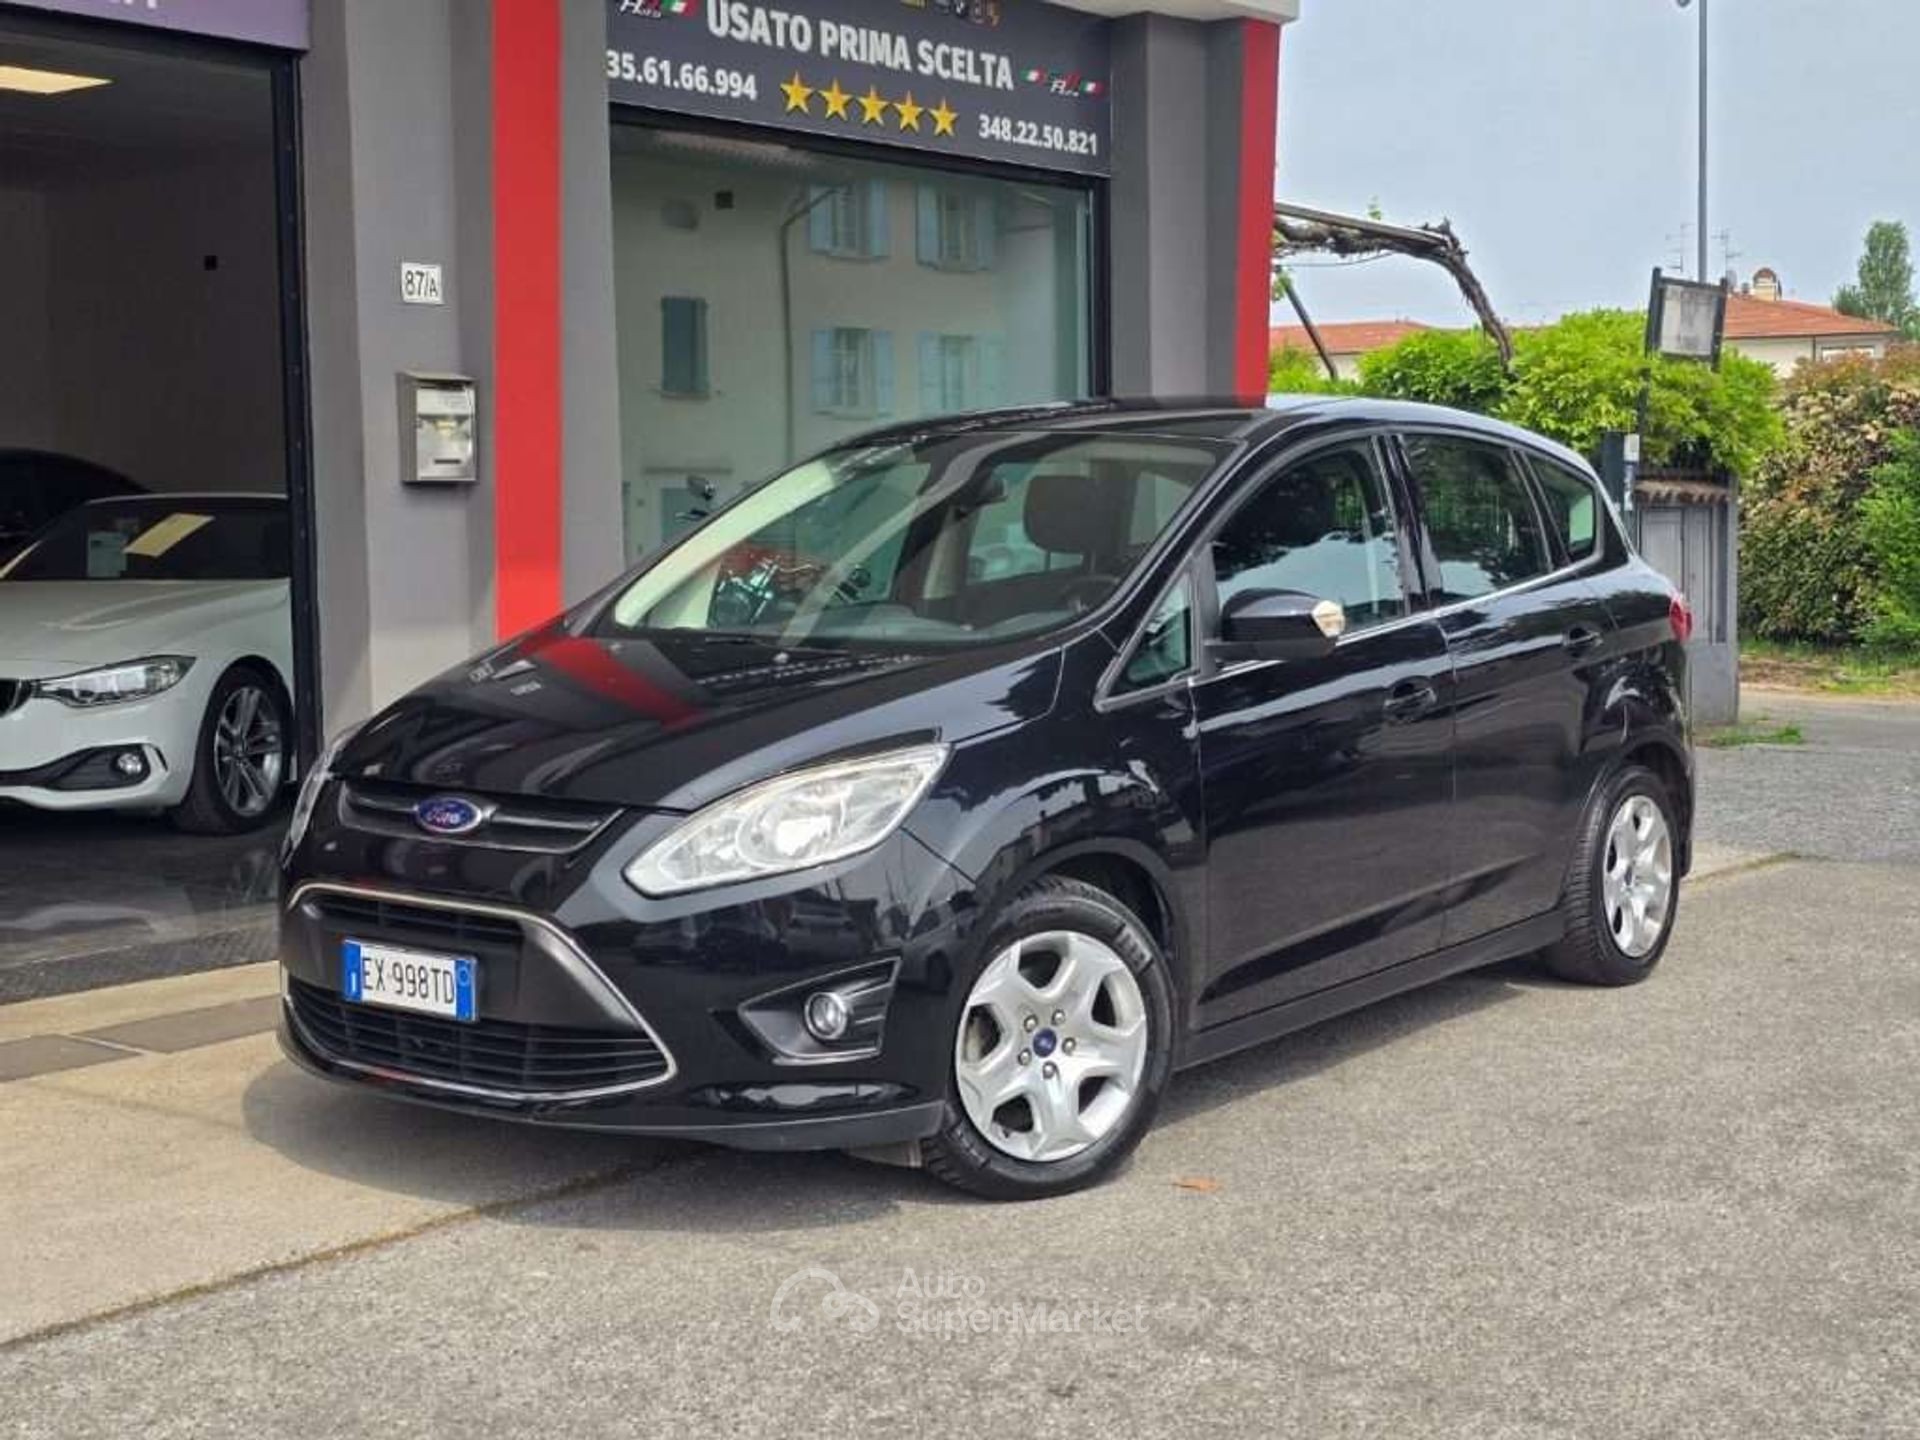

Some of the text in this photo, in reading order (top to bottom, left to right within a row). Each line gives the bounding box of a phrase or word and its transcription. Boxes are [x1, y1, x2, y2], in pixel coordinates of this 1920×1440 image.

[706, 0, 813, 52] USATO
[819, 19, 912, 72] PRIMA
[917, 38, 1014, 91] SCELTA
[606, 50, 757, 100] 35.61.66.994
[978, 113, 1097, 156] 348.22.50.821
[404, 269, 439, 298] 87/A
